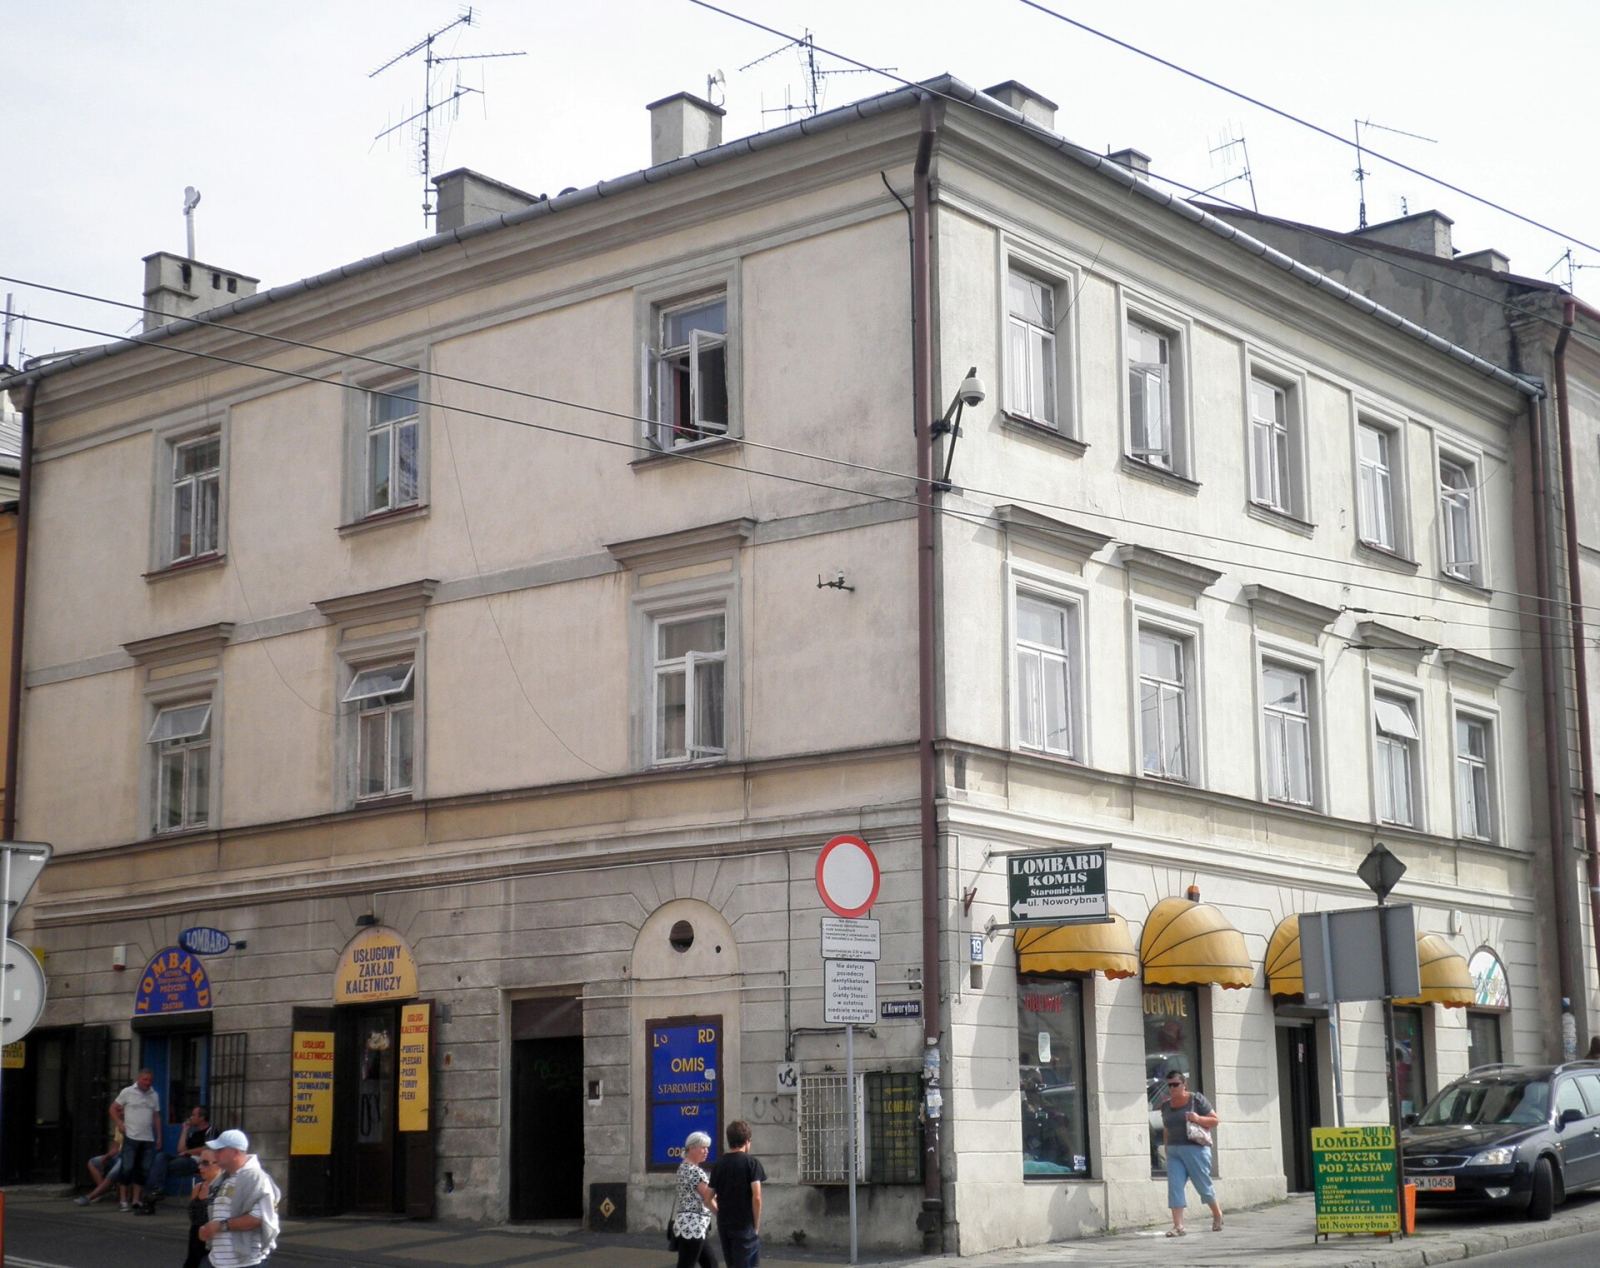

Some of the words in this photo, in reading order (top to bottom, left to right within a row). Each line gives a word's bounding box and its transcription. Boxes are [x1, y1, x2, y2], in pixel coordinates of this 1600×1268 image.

[1012, 854, 1103, 875] LOMBARD
[1028, 871, 1088, 886] KOMIS
[1030, 885, 1085, 896] Staromiejski
[1042, 896, 1098, 906] Noworybna
[186, 928, 230, 954] LOMBARD
[971, 940, 982, 954] 19
[353, 945, 402, 963] USŁUGOWY
[359, 961, 394, 978] ZAKŁAD
[137, 953, 209, 1011] LOMBARD
[345, 976, 402, 994] KALETNICZY
[1143, 992, 1188, 1017] OBUWIE
[671, 1057, 705, 1072] OMIS
[658, 1082, 713, 1094] STAROMIEJSKI
[1315, 1136, 1392, 1148] LOMBARD
[1324, 1151, 1382, 1162] POŻYCZKI
[1319, 1163, 1344, 1173] POD
[1346, 1162, 1393, 1173] ZASTAW
[1428, 1177, 1453, 1188] 10458
